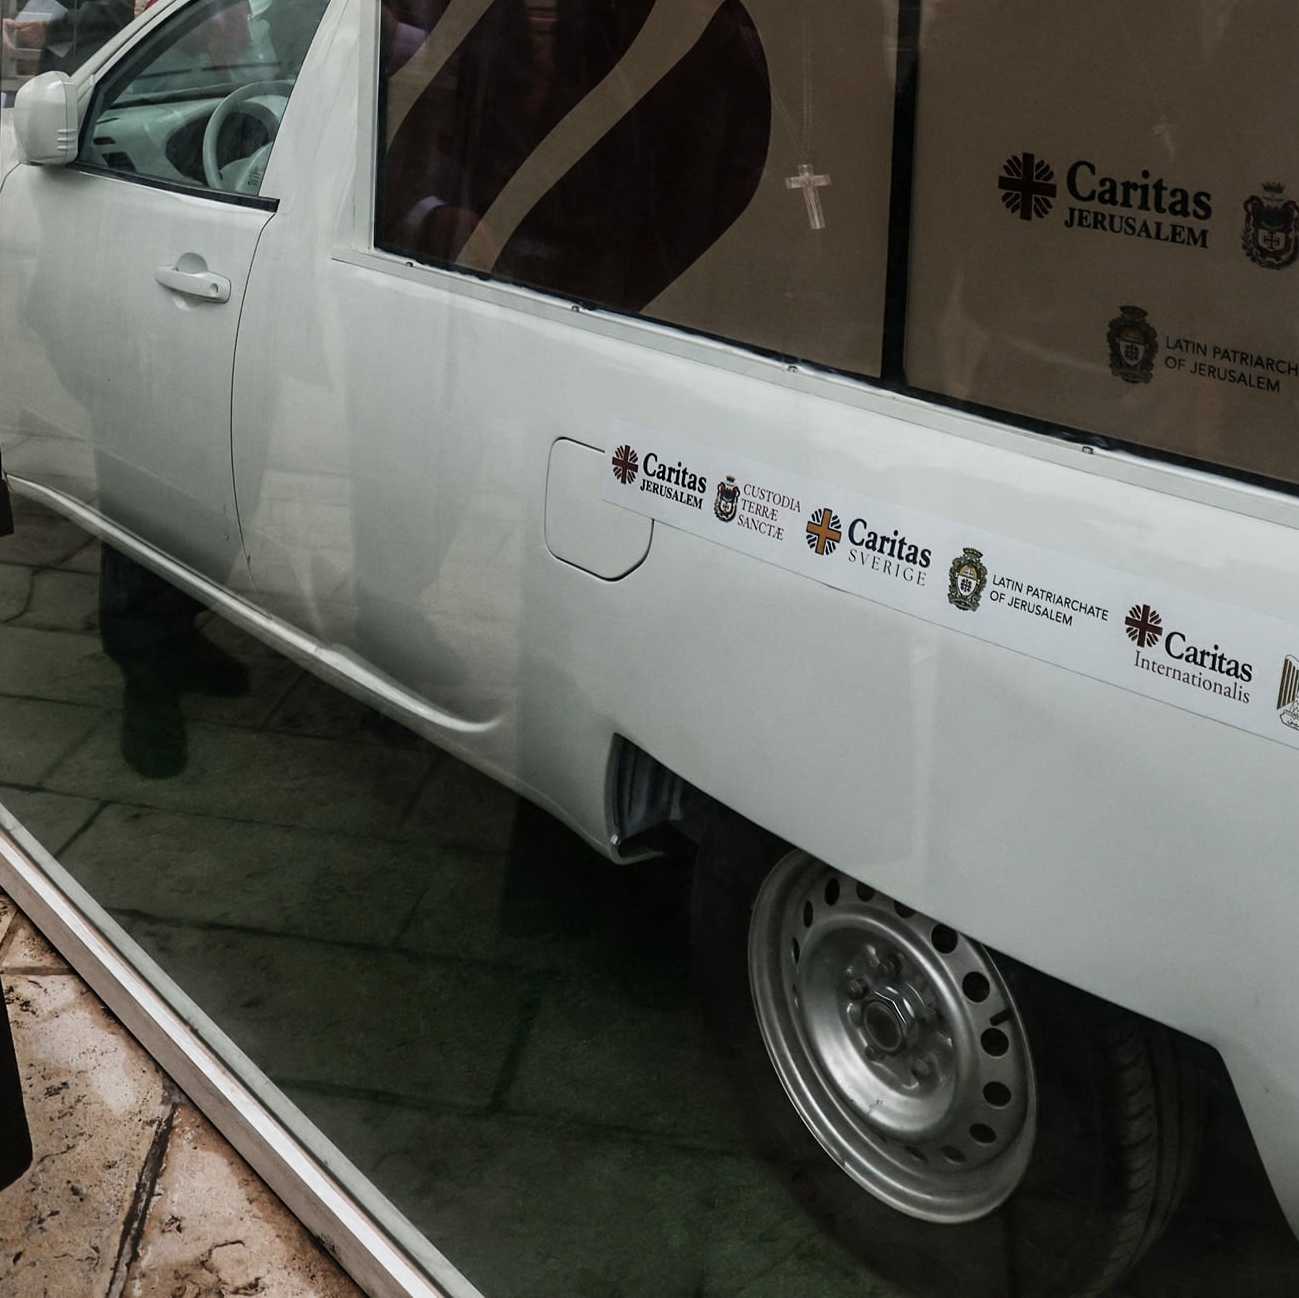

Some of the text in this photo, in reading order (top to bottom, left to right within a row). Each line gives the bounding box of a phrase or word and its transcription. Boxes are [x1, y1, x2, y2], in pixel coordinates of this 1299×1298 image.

[1066, 160, 1213, 220] Caritas
[1064, 207, 1209, 248] JERUSALEM
[1165, 335, 1207, 357] LATIN
[1164, 355, 1281, 393] OF JERUSALEM
[643, 452, 707, 494] Caritas
[640, 478, 703, 510] JERUSALEM
[743, 483, 801, 513] CUSTODIA
[847, 518, 932, 569] Caritas
[847, 548, 927, 587] SVERIGE
[989, 590, 1073, 627] OF JERUSALEM
[992, 574, 1109, 622] LATIN PATRIARCHATE
[1133, 650, 1251, 704] Internationalis
[1165, 631, 1253, 683] Caritas
